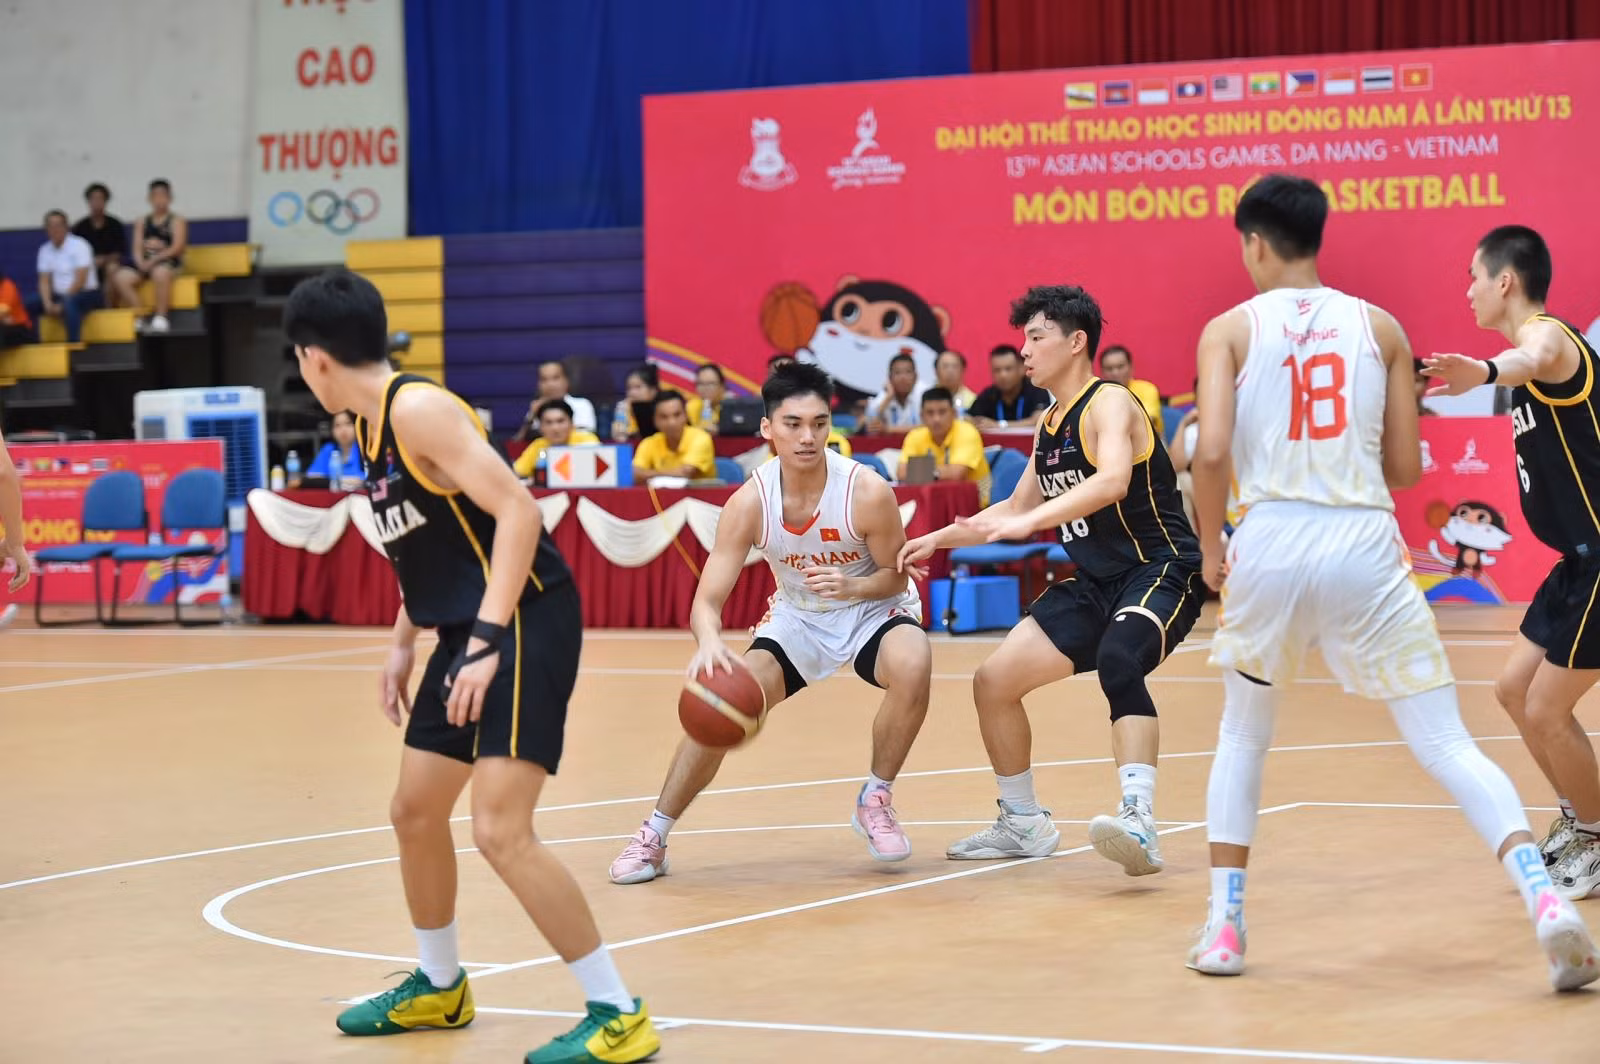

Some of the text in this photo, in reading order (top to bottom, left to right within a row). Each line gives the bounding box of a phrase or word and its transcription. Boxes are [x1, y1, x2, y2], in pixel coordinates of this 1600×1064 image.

[296, 44, 376, 88] CAO
[1075, 116, 1142, 143] THAO
[1145, 113, 1200, 143] HỌC
[1204, 111, 1262, 137] SINH
[1347, 102, 1408, 128] NAM
[1546, 94, 1572, 121] 13
[1043, 153, 1107, 176] ASEAN
[1110, 147, 1206, 174] SCHOOLS
[1290, 142, 1320, 165] DA
[1324, 138, 1388, 163] NANG
[1404, 133, 1499, 159] VIETNAM
[1013, 185, 1099, 226] MÔN
[1320, 173, 1506, 213] ASKETBALL
[1281, 351, 1348, 442] 18
[22, 516, 80, 545] ÓNG
[810, 550, 862, 566] NAM
